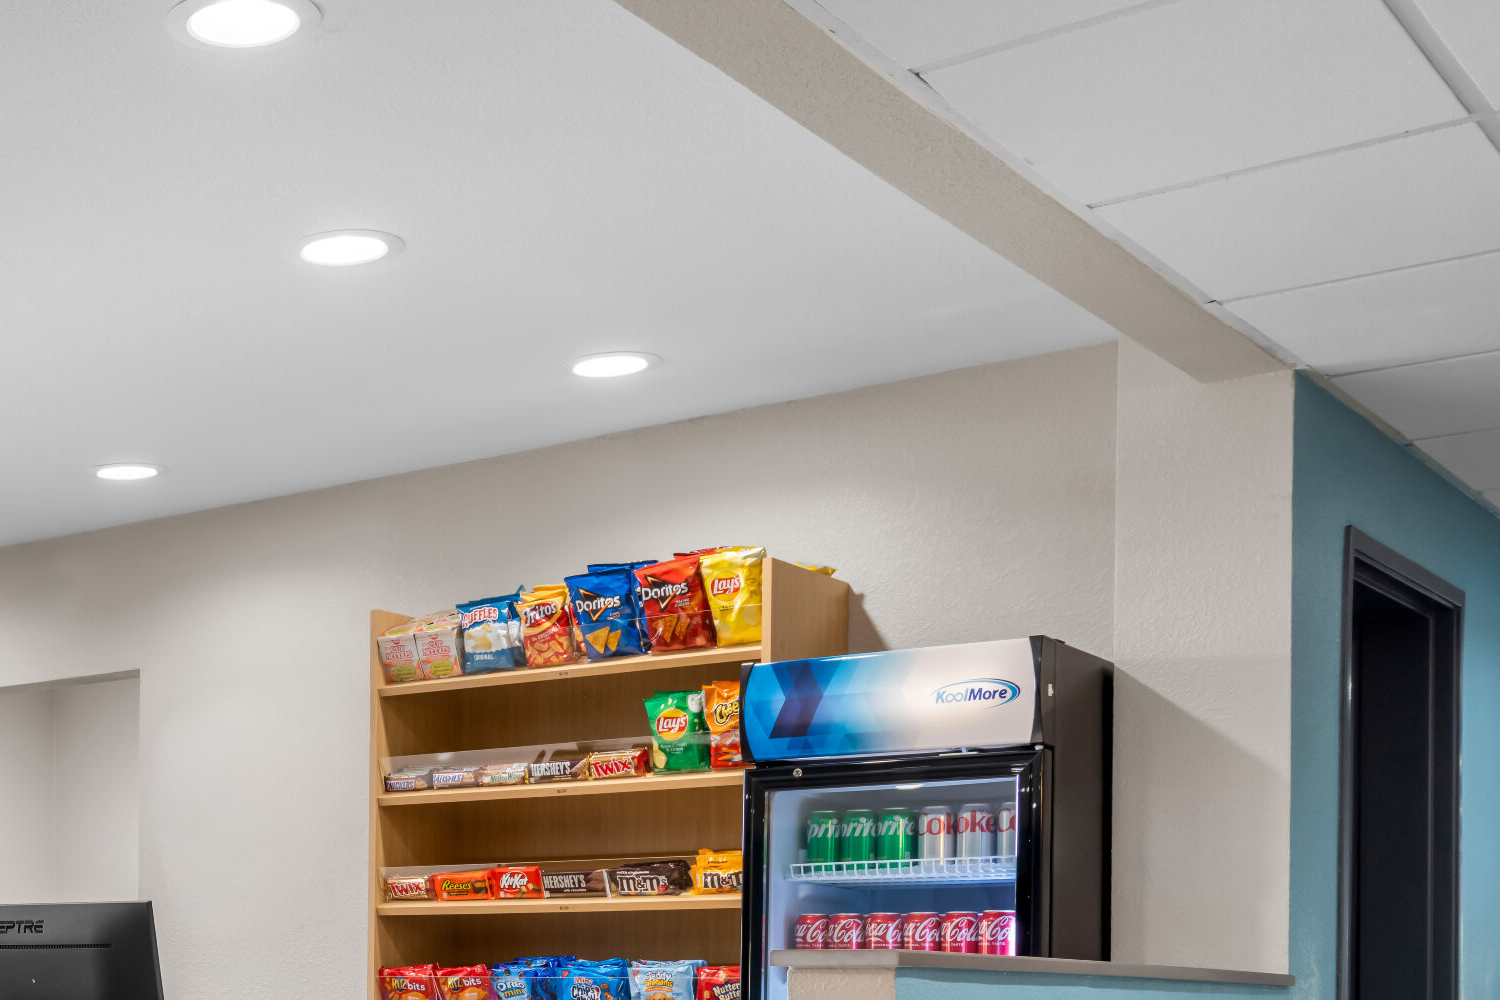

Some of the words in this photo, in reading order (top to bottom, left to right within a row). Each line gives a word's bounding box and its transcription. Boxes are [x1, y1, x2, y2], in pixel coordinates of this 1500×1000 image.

[641, 582, 689, 602] Doritos
[712, 575, 741, 595] Lay's
[575, 595, 621, 613] Doritos
[522, 602, 558, 627] Fritos
[935, 687, 1008, 704] KoolMore
[715, 701, 740, 726] Chee
[658, 714, 687, 734] Lay's
[530, 761, 571, 777] HERSHEY'S
[918, 812, 955, 836] Cok
[957, 810, 997, 834] oke
[543, 875, 586, 889] HERSHEY'S
[702, 871, 742, 889] m&m
[407, 981, 426, 991] bits
[462, 978, 482, 987] bits
[713, 983, 740, 997] Nutter
